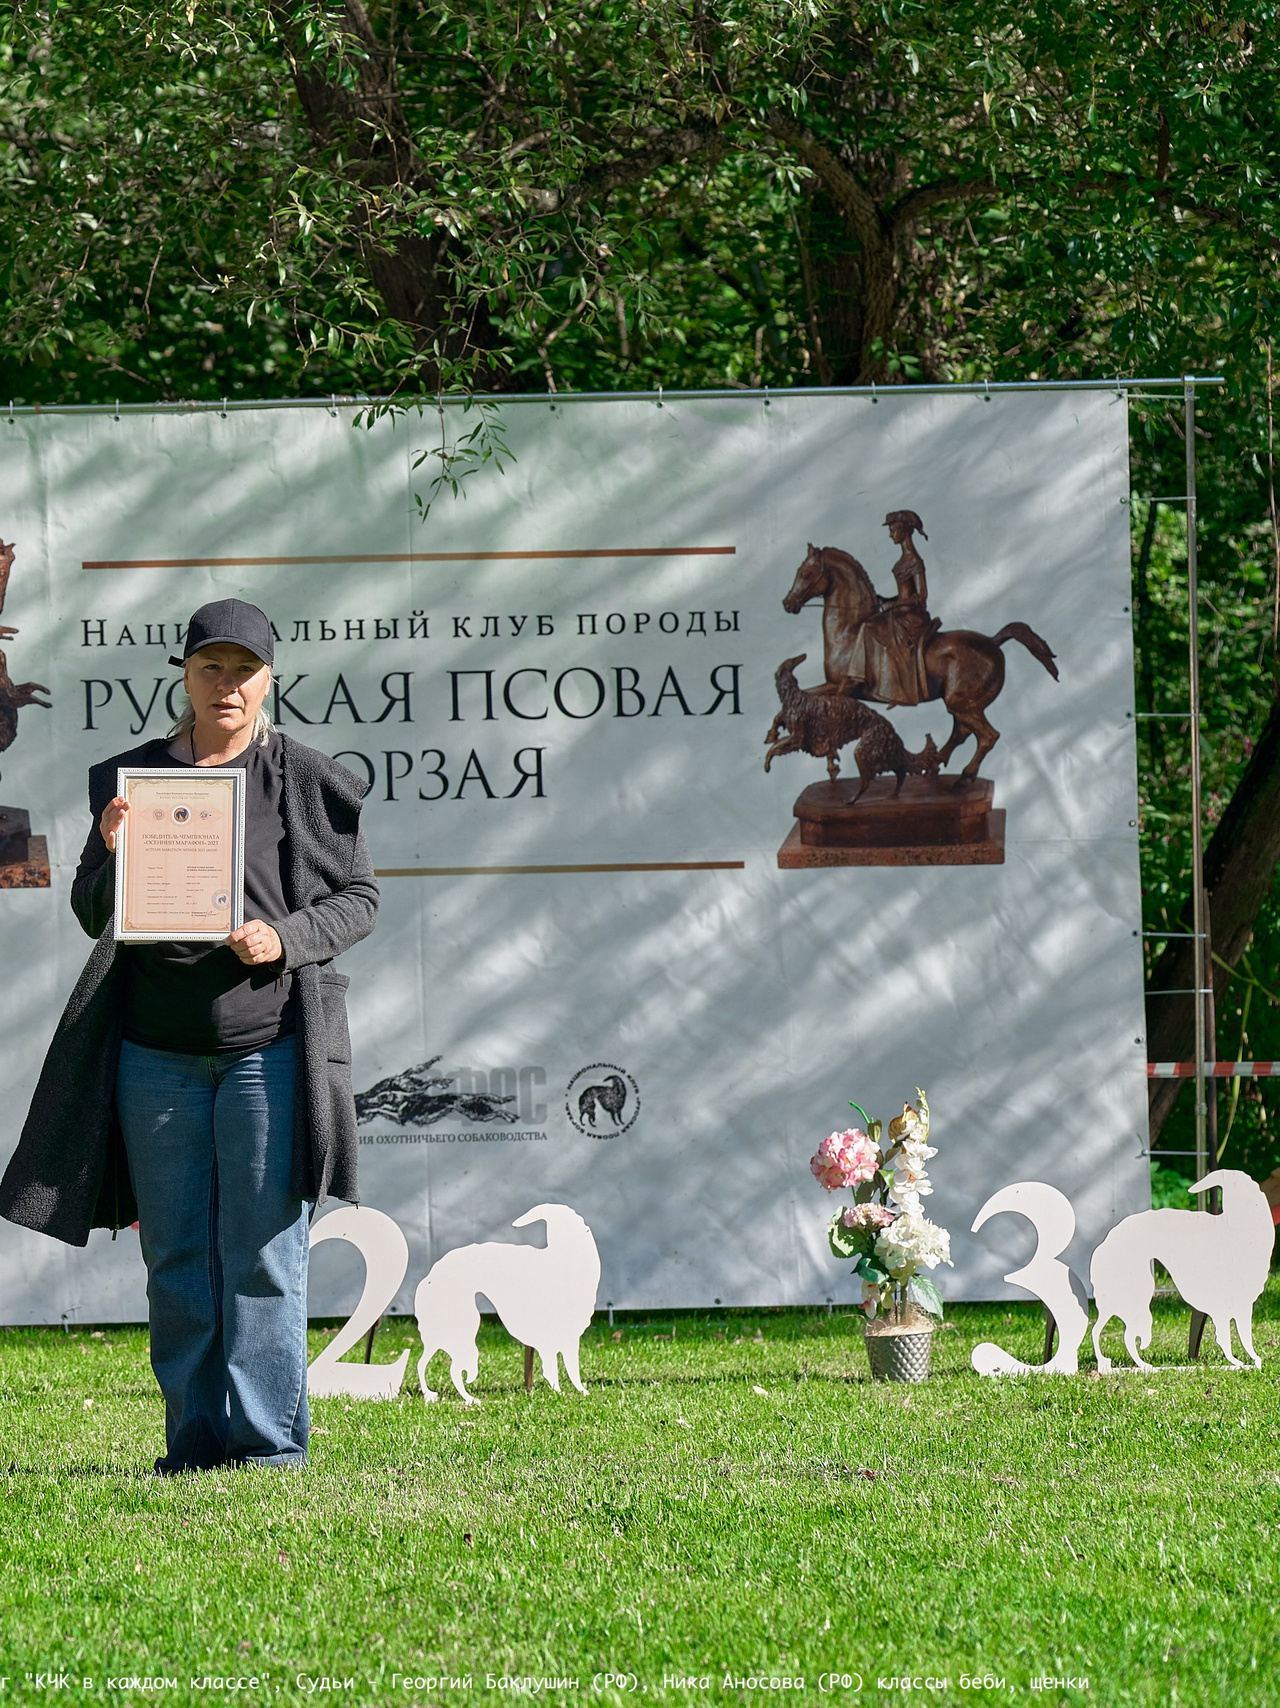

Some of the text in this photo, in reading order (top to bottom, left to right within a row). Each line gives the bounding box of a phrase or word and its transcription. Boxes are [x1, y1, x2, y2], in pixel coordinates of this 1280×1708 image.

[81, 609, 741, 649] НАЦИЛЬНЫЙ КЛУБ ПОРОДЫ
[80, 663, 745, 735] РУКАЯ ПСОВАЯ
[332, 747, 548, 802] ОРЗАЯ
[567, 1062, 639, 1094] НАЦИОНАЛЬНЫЙ КЛУБ
[376, 1134, 456, 1145] ОХОТНИЧЬЕГО
[457, 1132, 548, 1143] СОБАКОВОДСТВА
[307, 1206, 411, 1399] 2
[971, 1181, 1088, 1376] 3
